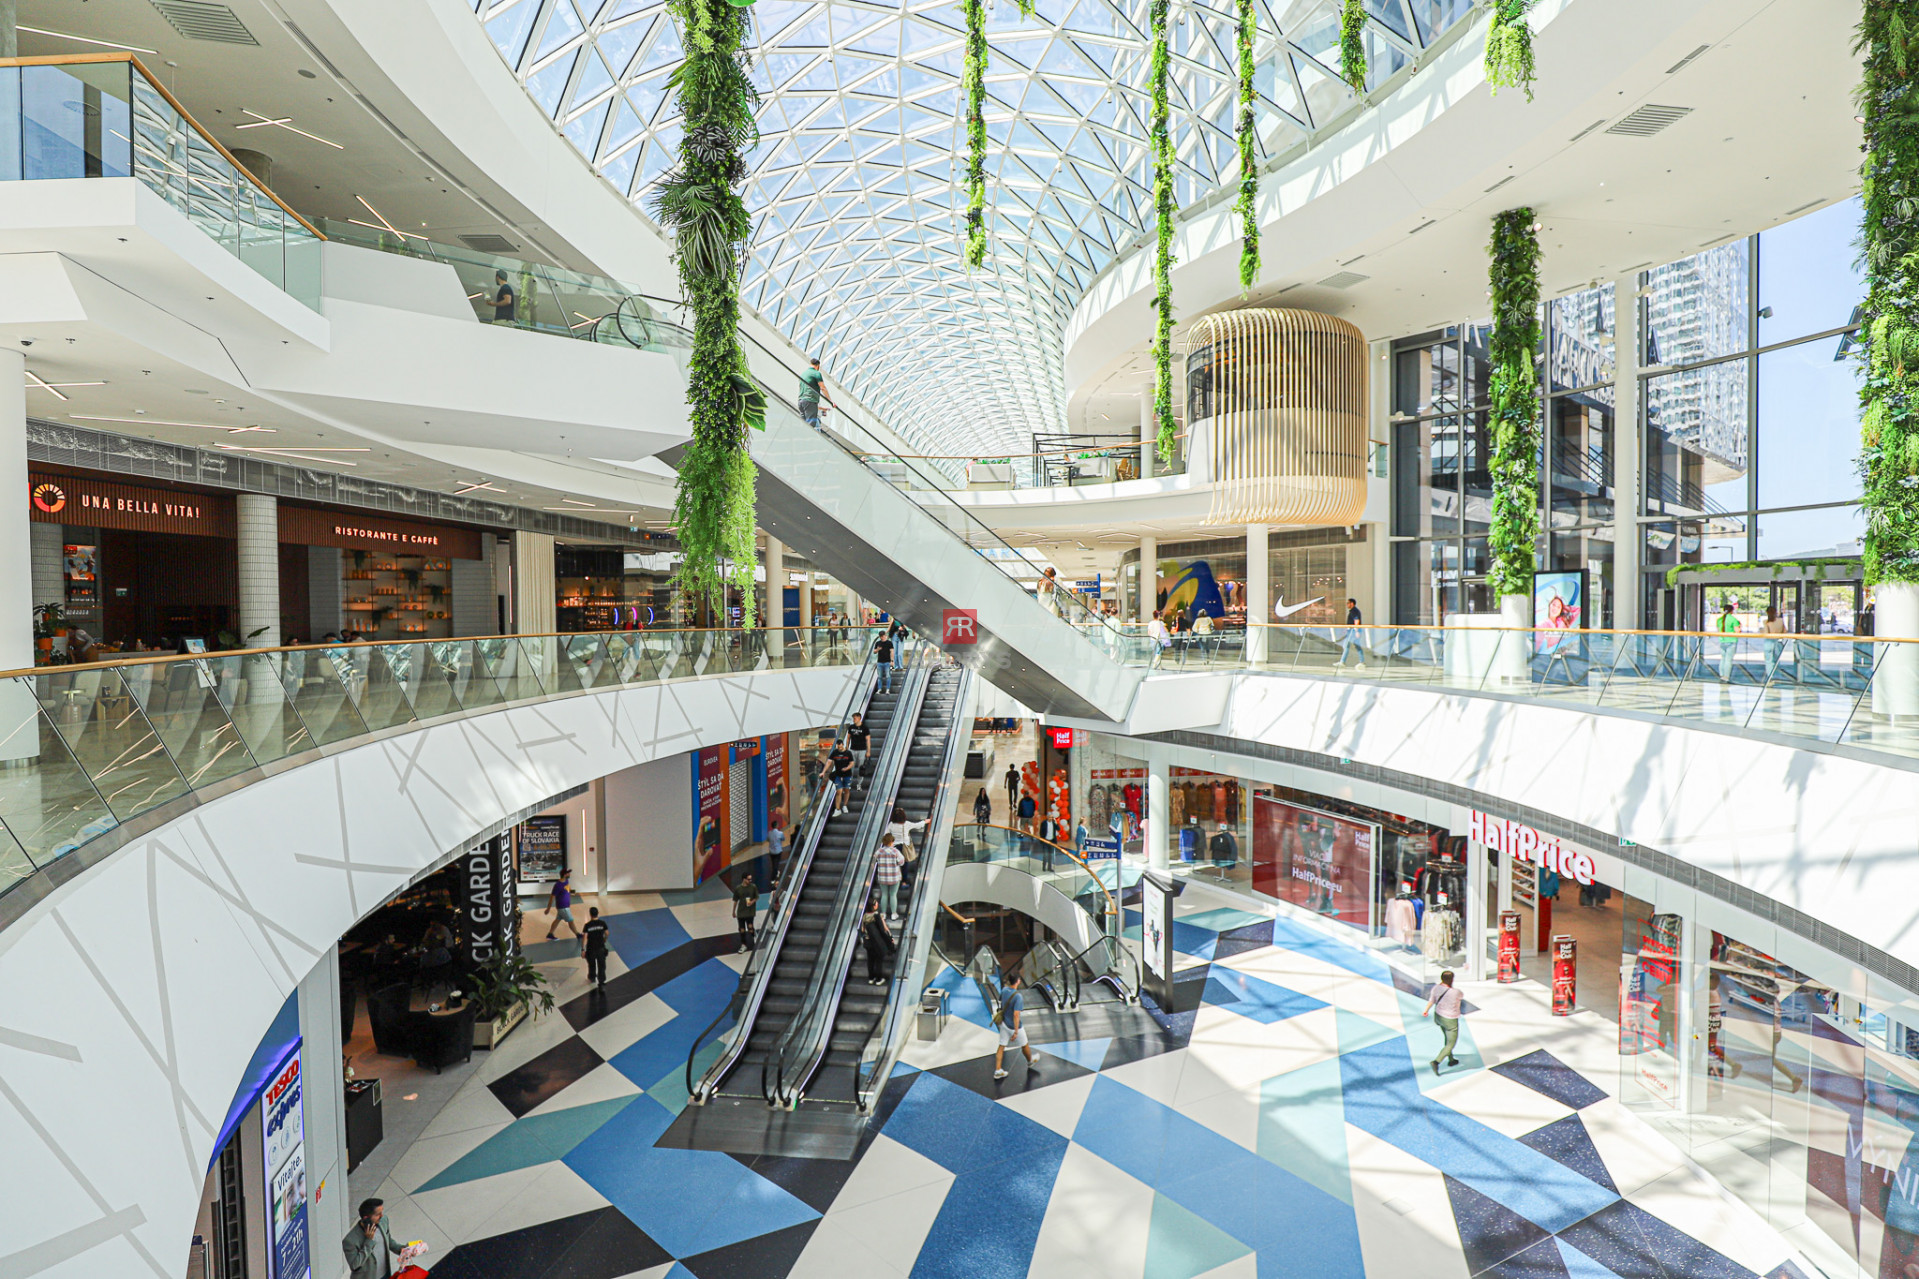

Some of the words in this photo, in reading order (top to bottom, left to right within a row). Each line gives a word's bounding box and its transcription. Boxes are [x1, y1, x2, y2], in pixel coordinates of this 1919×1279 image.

[82, 494, 110, 510] UNA
[117, 498, 159, 515] BELLA
[165, 503, 201, 519] VITA!
[335, 526, 398, 541] RISTORANTE
[402, 534, 408, 543] E
[1056, 731, 1070, 739] Half
[710, 775, 718, 785] SA
[1355, 831, 1371, 842] Half
[1355, 839, 1371, 850] Price
[1467, 809, 1596, 886] HalfPrice
[469, 842, 492, 923] GARDE
[266, 1059, 299, 1106] TESCO
[1847, 1122, 1919, 1211] VÝNI
